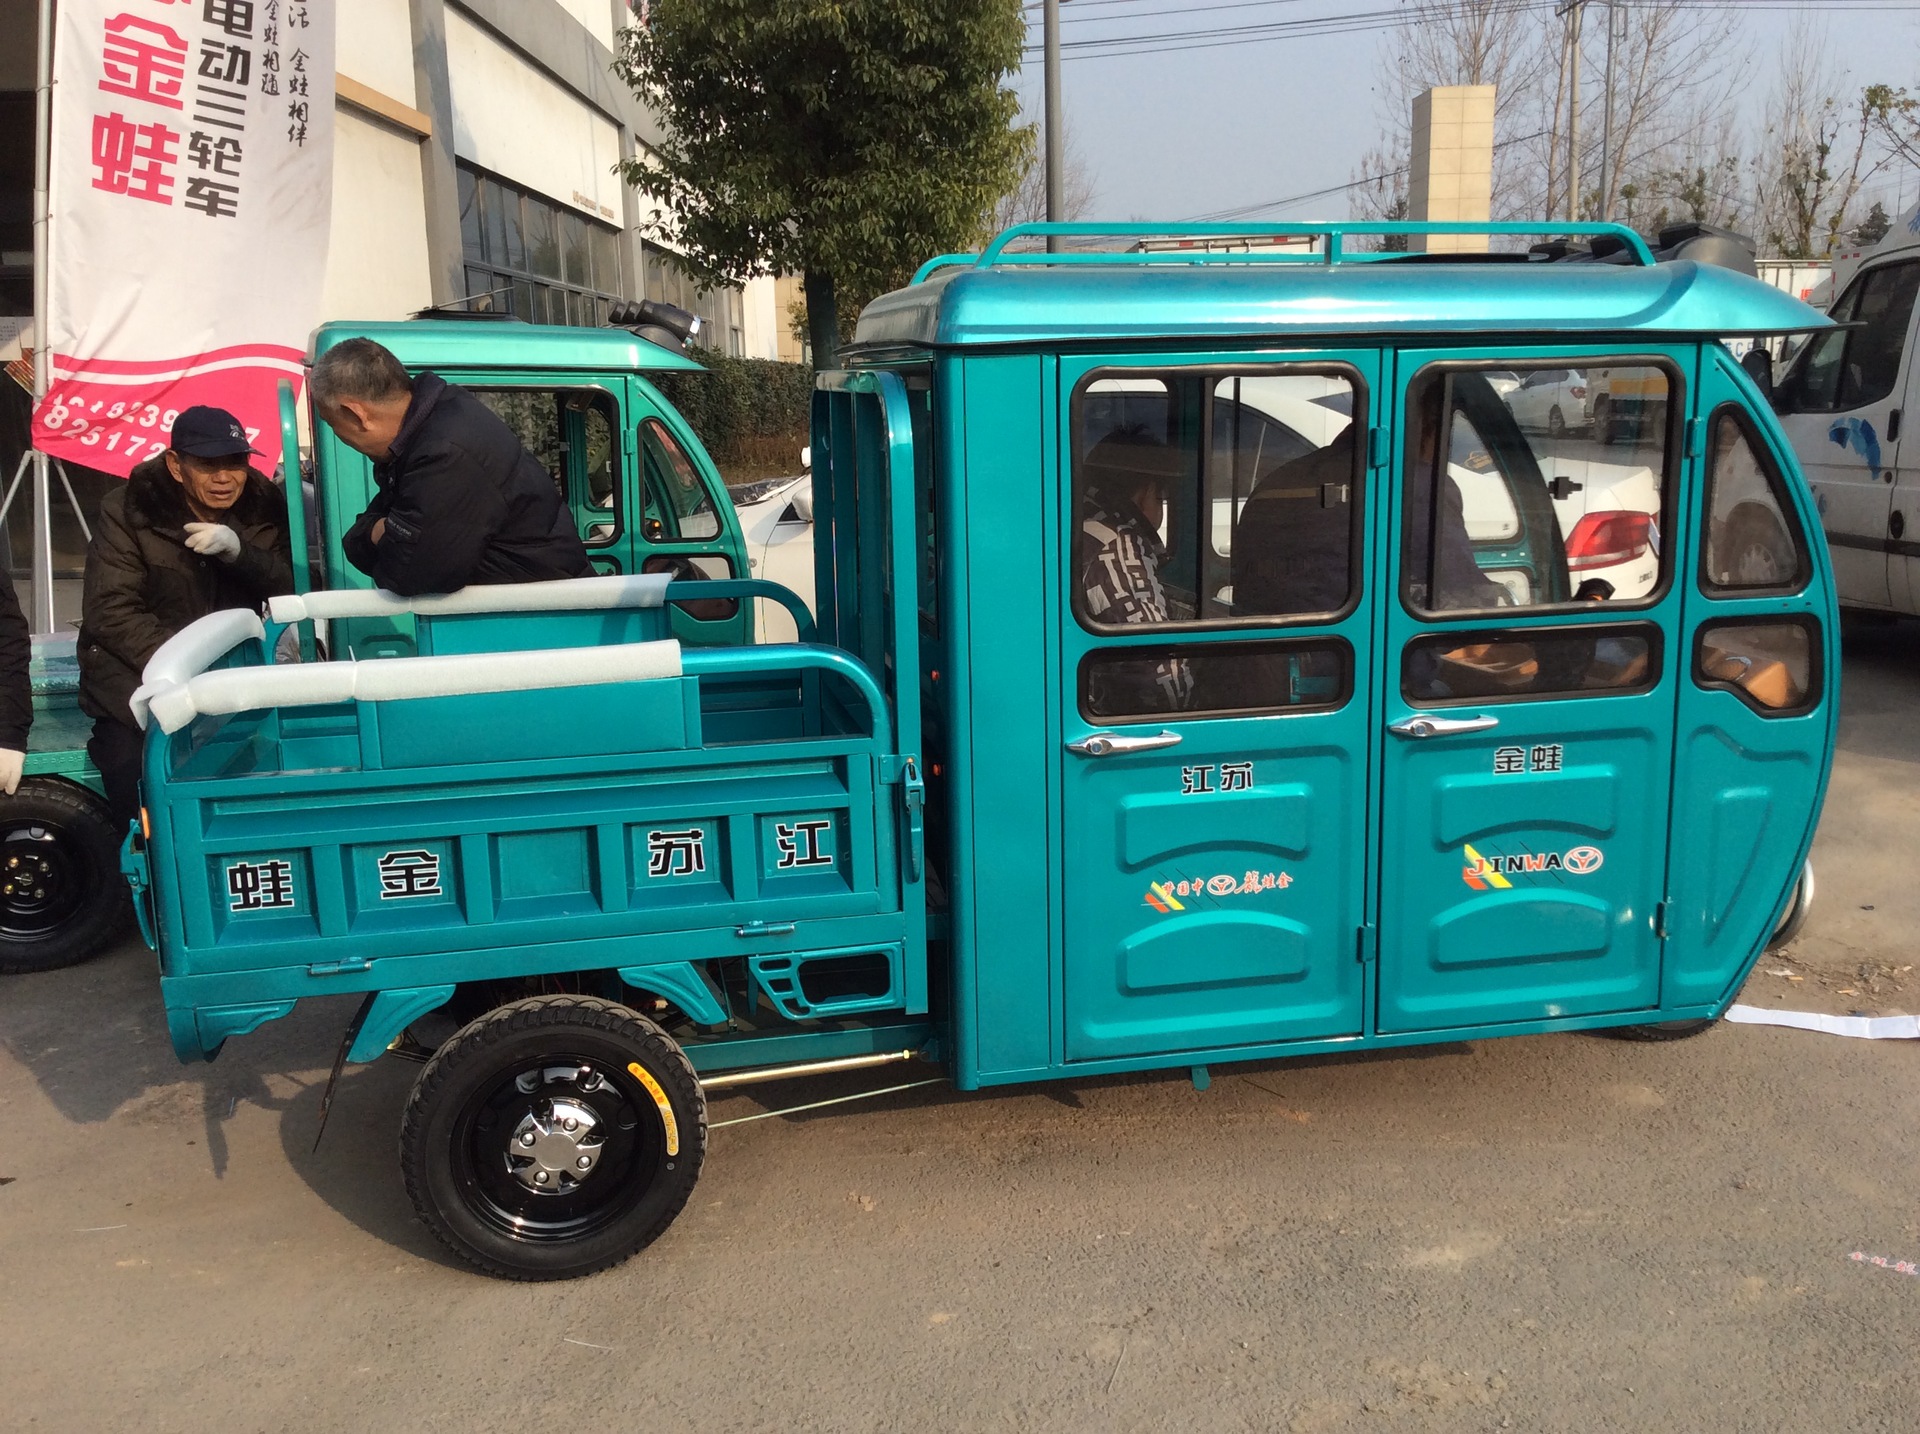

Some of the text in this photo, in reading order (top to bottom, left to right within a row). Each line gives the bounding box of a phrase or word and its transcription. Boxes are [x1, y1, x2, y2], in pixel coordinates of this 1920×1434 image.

[92, 0, 192, 206] 金蛙
[184, 0, 254, 217] 电动三轮车
[1492, 744, 1564, 775] 金蛙
[1181, 762, 1254, 795] 江苏
[1466, 852, 1562, 876] JINWA
